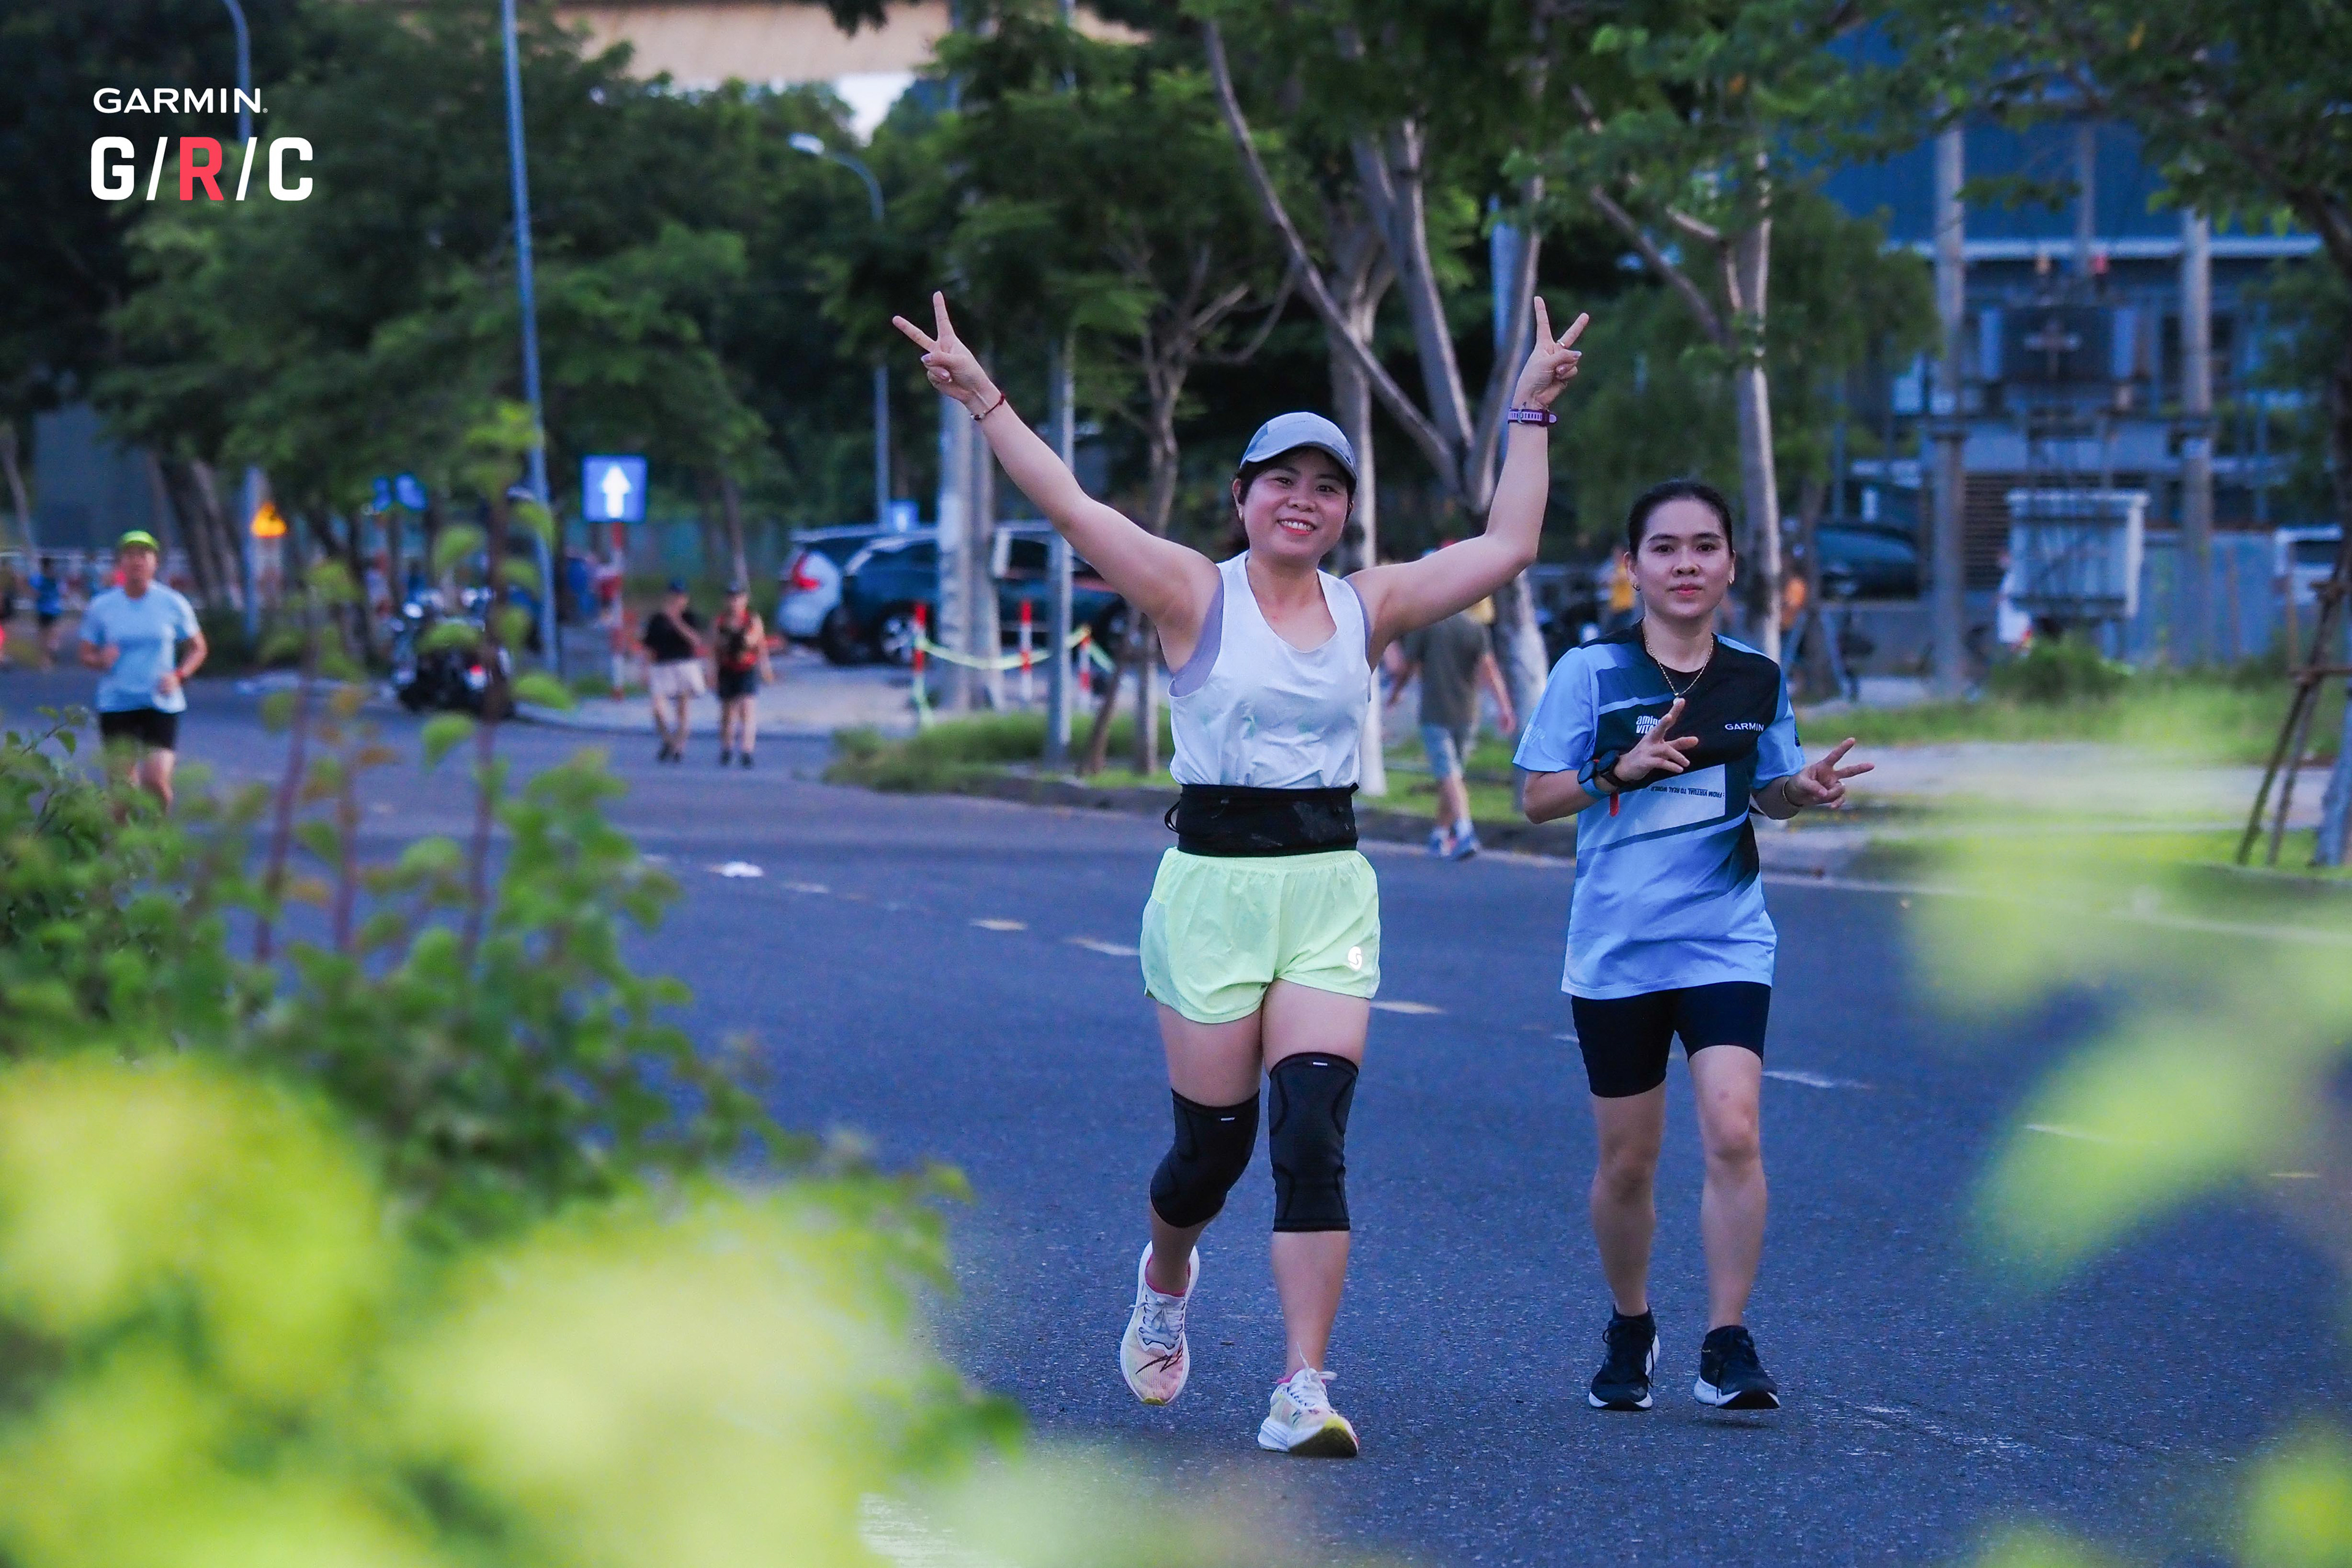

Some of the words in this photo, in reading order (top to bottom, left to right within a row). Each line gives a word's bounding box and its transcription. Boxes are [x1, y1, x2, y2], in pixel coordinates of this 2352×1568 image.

[1636, 715, 1661, 725] amin
[1724, 722, 1764, 732] GARMIN
[1688, 788, 1708, 797] VIRTUAL
